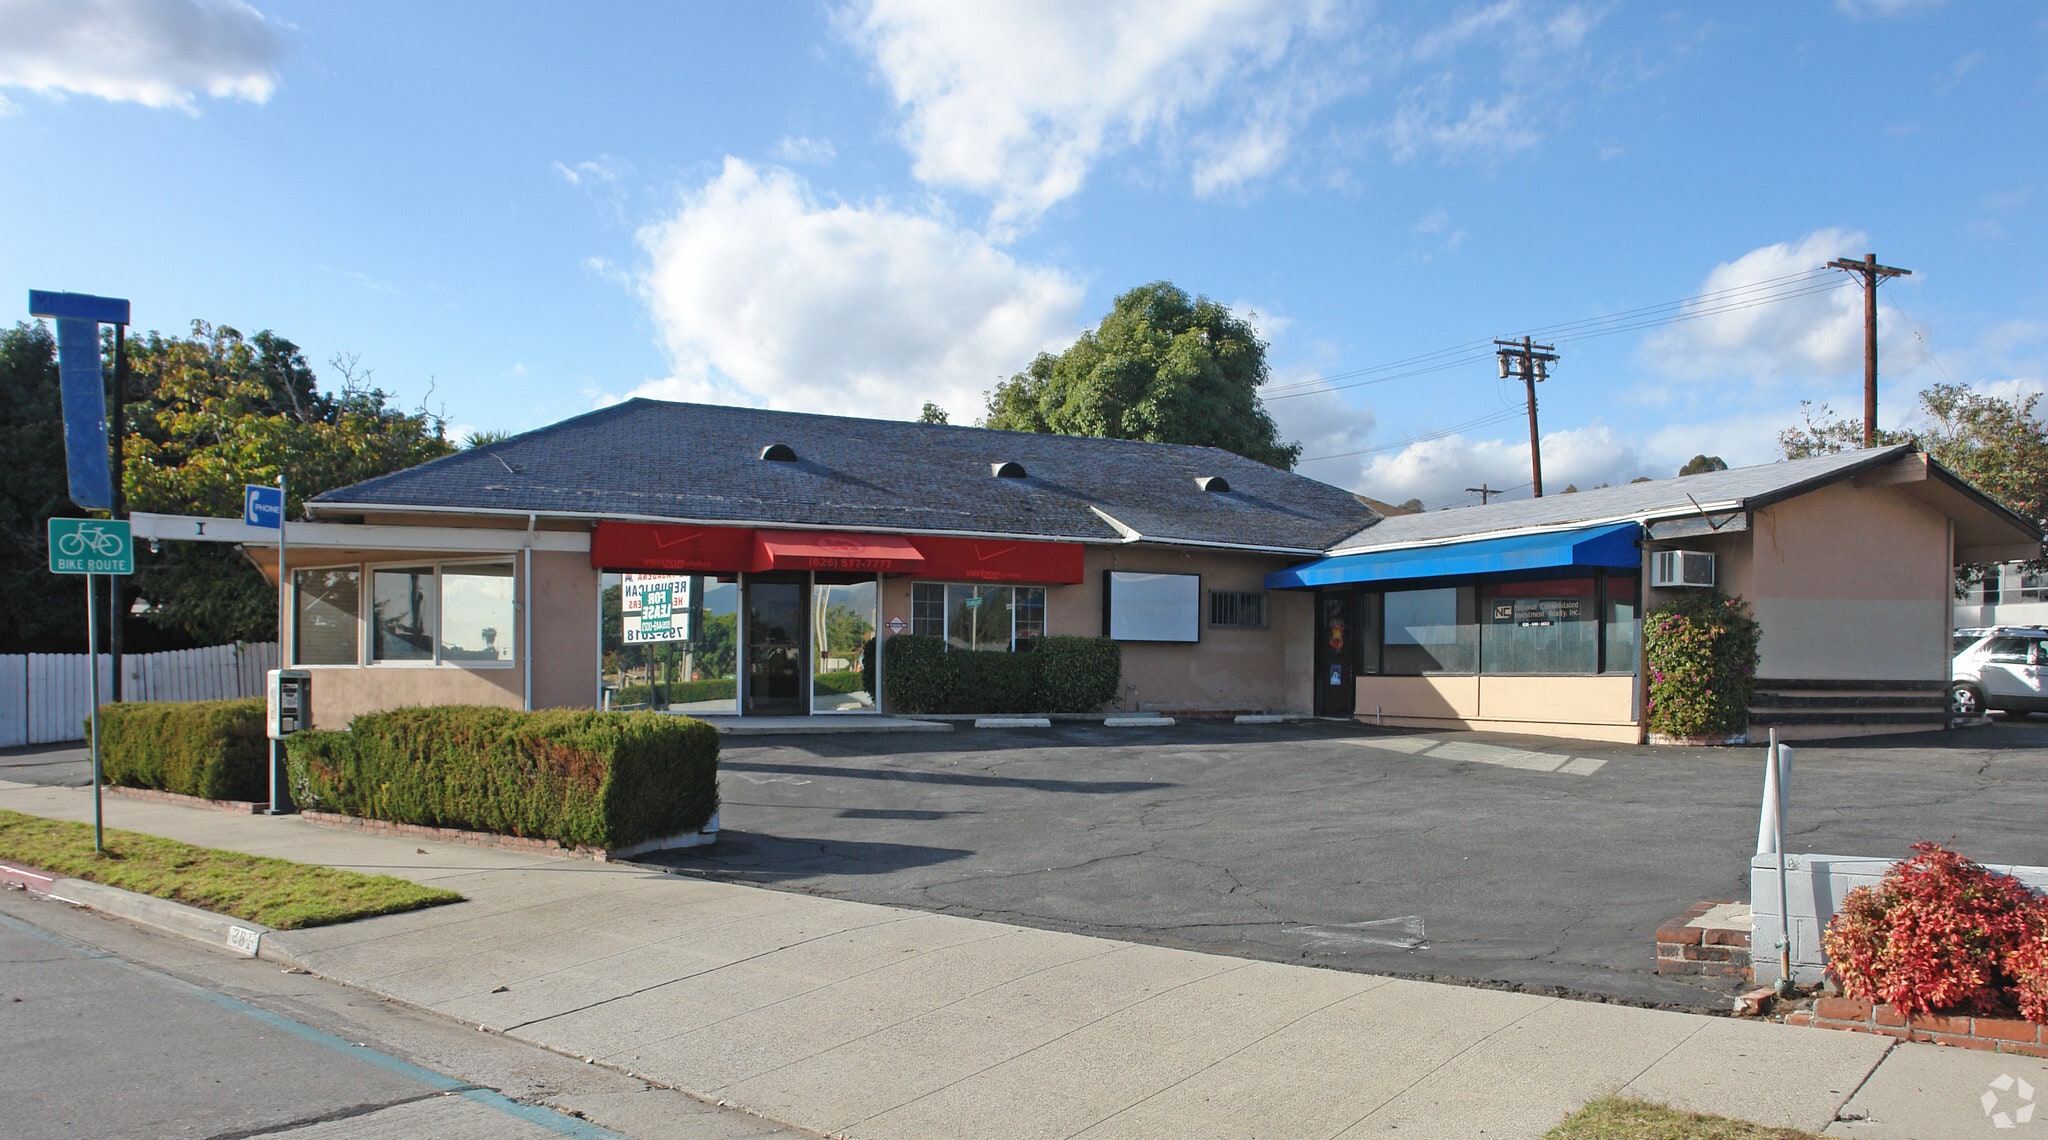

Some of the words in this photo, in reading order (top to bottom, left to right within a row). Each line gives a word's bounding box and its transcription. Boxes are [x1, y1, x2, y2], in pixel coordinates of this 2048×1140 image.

[255, 503, 280, 513] PHONE
[58, 559, 83, 570] BIKE
[88, 560, 125, 571] ROUTE
[809, 557, 837, 568] (626)
[841, 558, 892, 569] 577-7777
[1514, 610, 1545, 618] Investment
